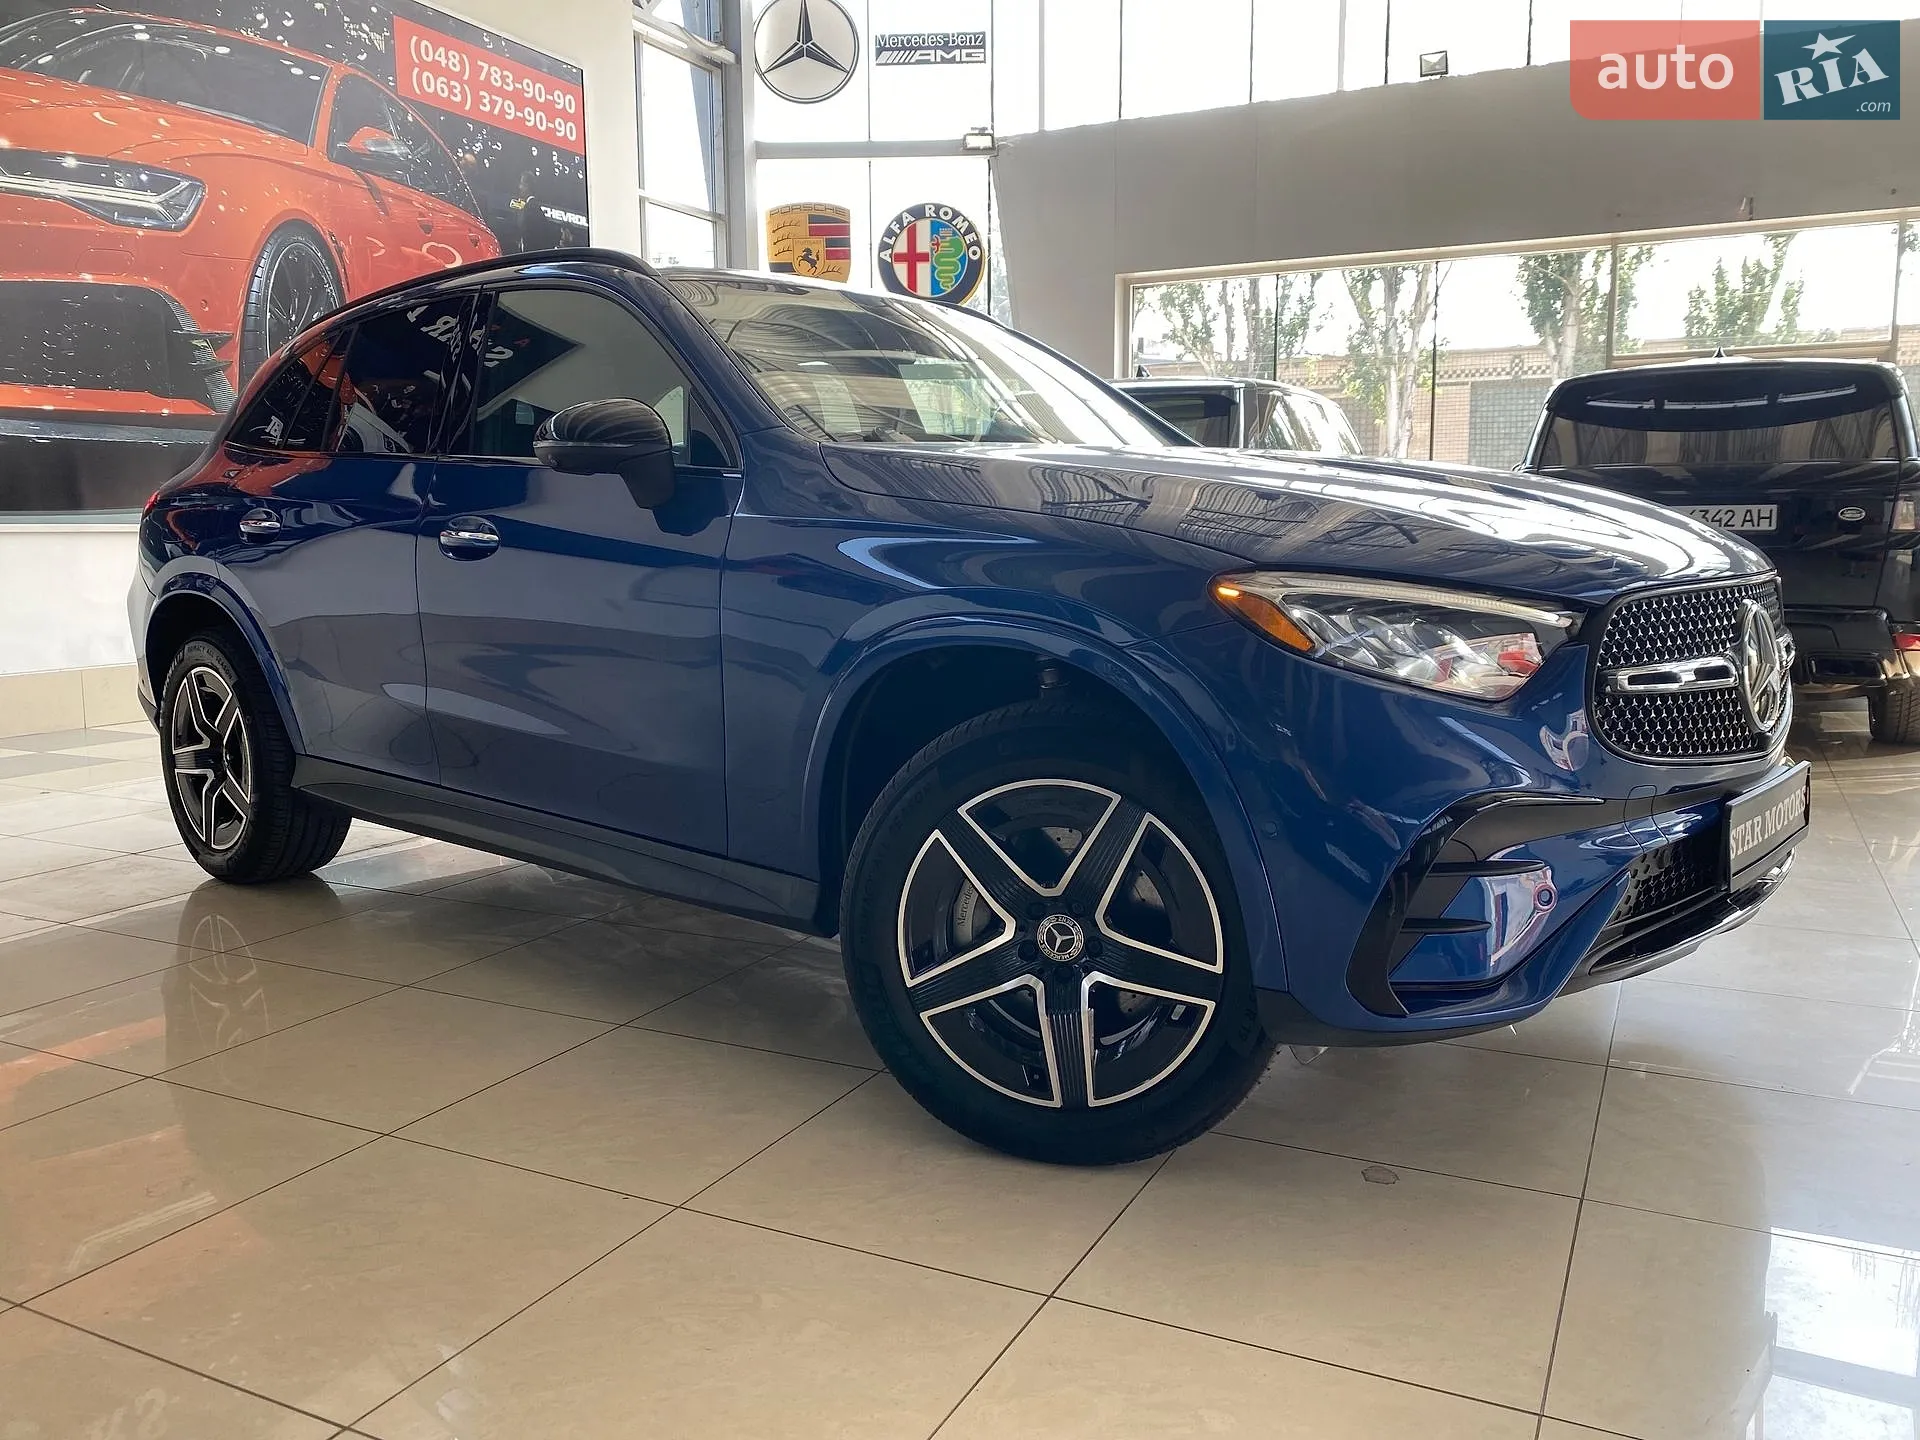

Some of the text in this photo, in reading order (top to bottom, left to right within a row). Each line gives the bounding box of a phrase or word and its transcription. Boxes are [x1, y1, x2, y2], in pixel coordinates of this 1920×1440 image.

[875, 33, 984, 48] Mercedes-Benz
[410, 35, 576, 114] (048) 783-90-90
[412, 67, 577, 141] (063) 379-90-90
[769, 203, 848, 217] PORSCHE
[880, 204, 981, 263] ALFA ROMEO
[1741, 509, 1773, 528] AH
[1730, 784, 1807, 860] STAR MOTORS
